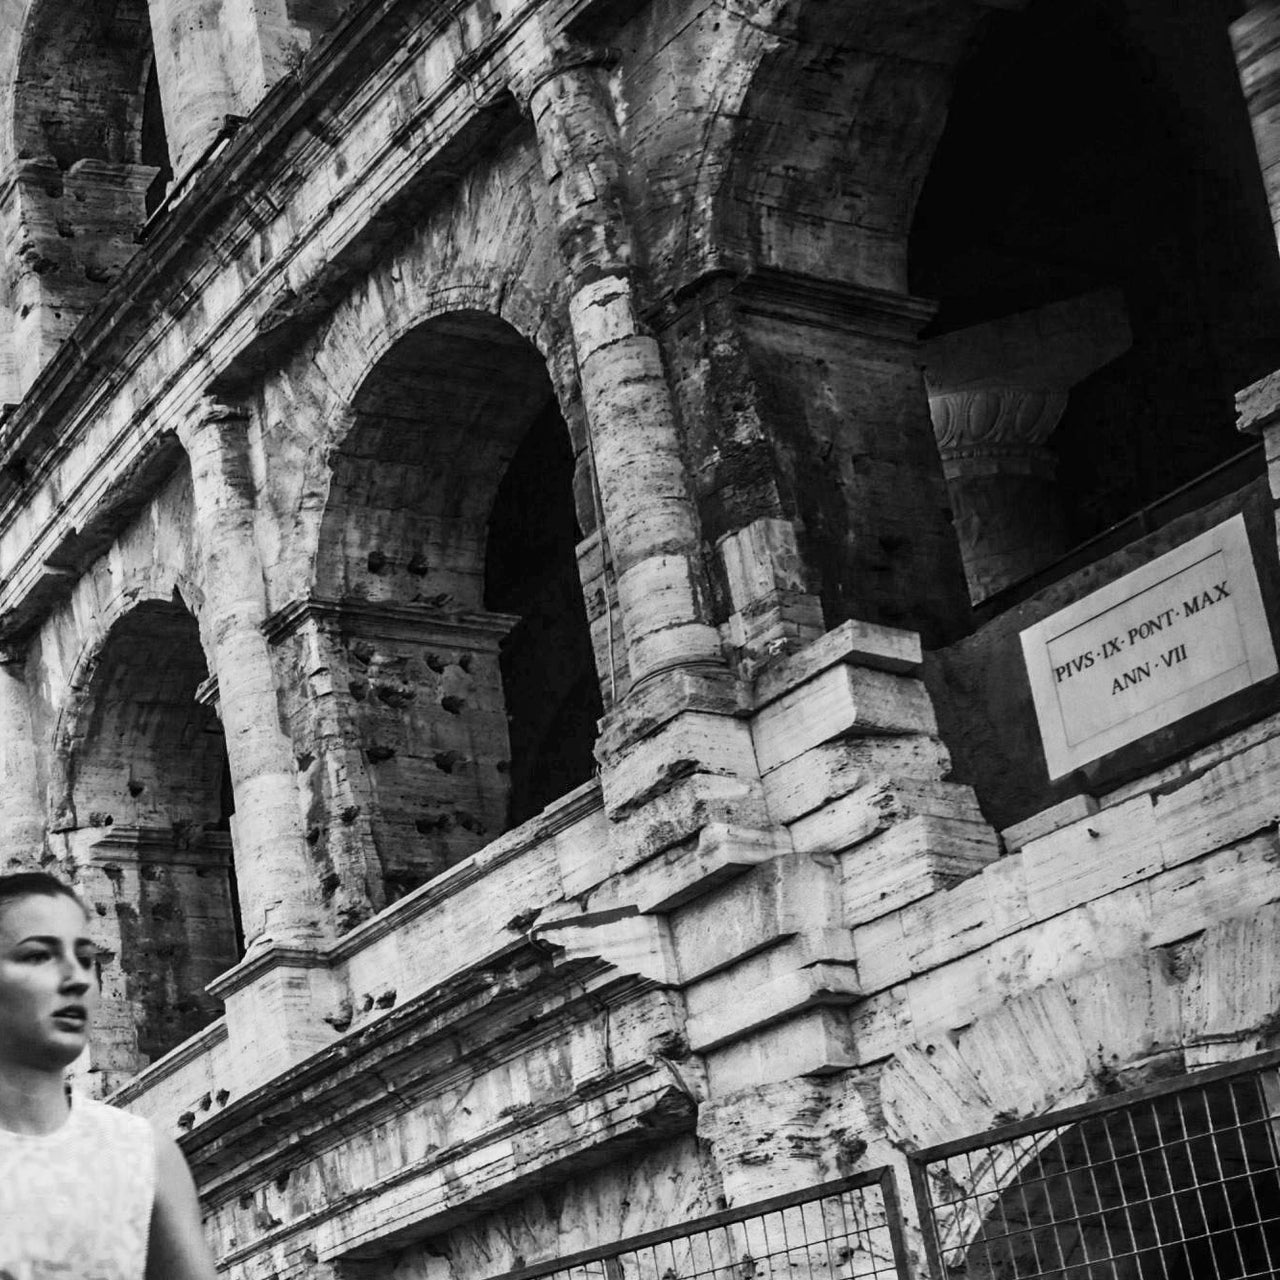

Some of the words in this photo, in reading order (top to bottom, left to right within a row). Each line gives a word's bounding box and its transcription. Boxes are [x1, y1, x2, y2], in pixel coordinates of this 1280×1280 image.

[1182, 580, 1232, 618] MAX
[1110, 661, 1153, 696] ANN
[1160, 643, 1188, 669] VII
